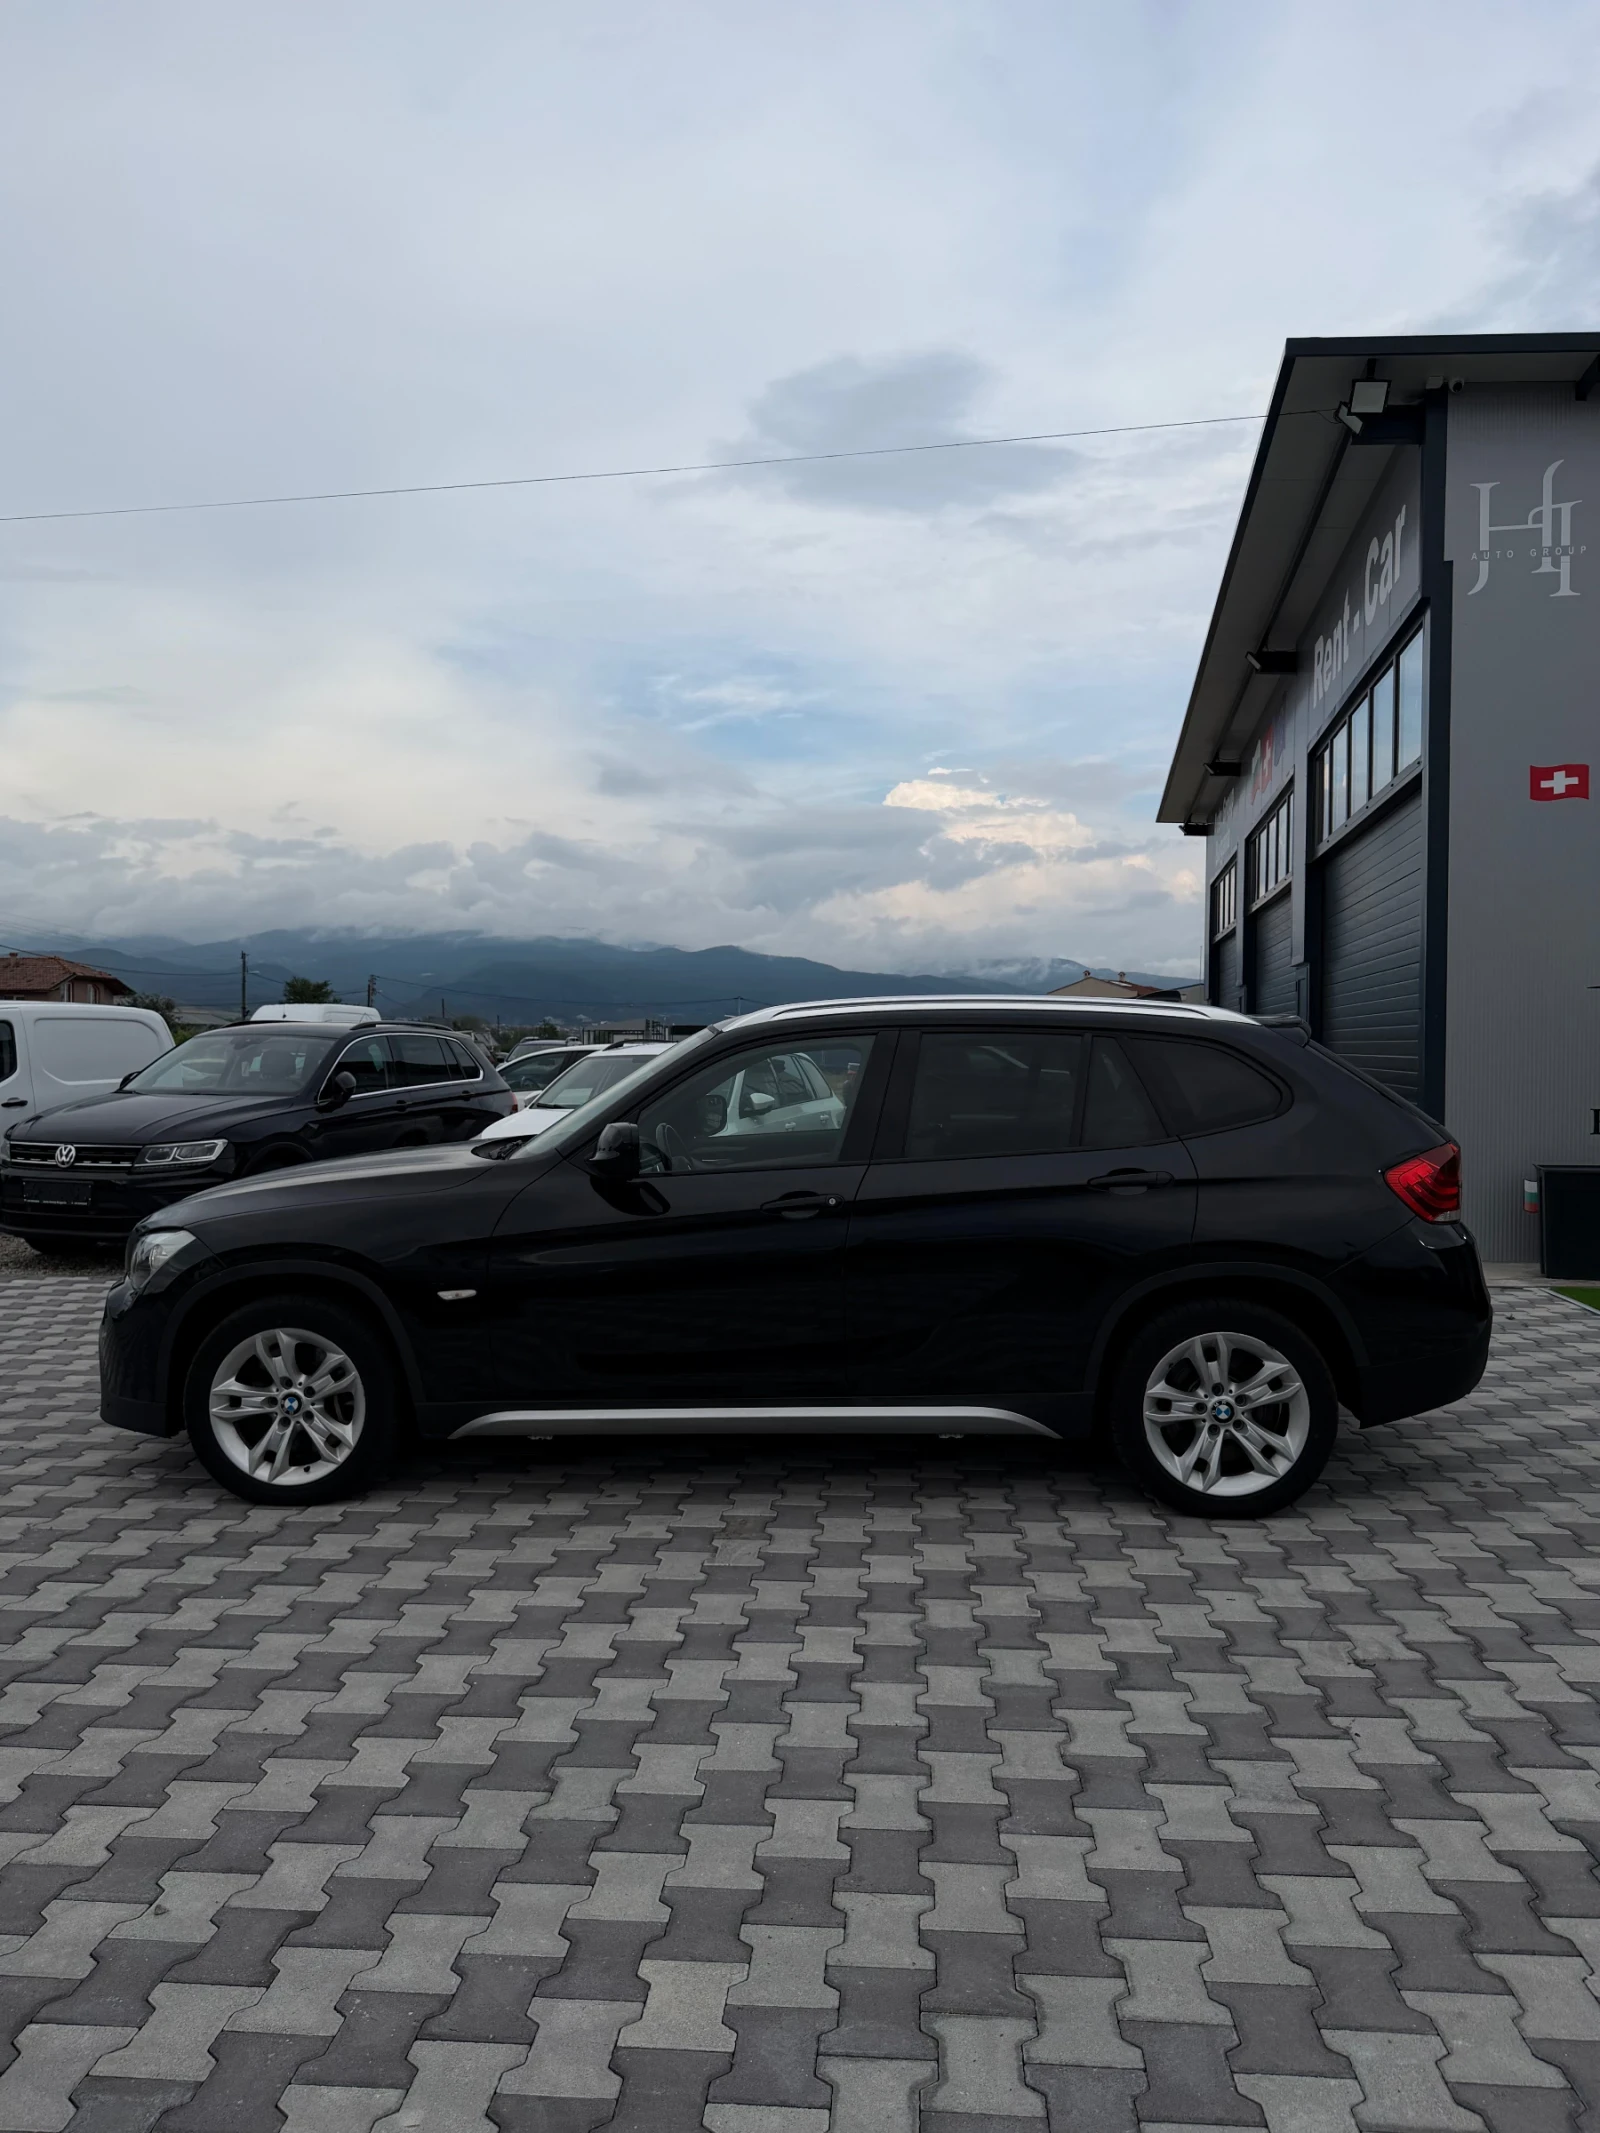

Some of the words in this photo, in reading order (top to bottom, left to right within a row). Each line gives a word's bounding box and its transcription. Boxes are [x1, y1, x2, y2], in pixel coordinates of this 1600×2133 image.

[1313, 587, 1350, 709] Rent
[1364, 504, 1407, 626] Car
[1471, 550, 1514, 561] AUTO
[1530, 546, 1586, 557] GROUP
